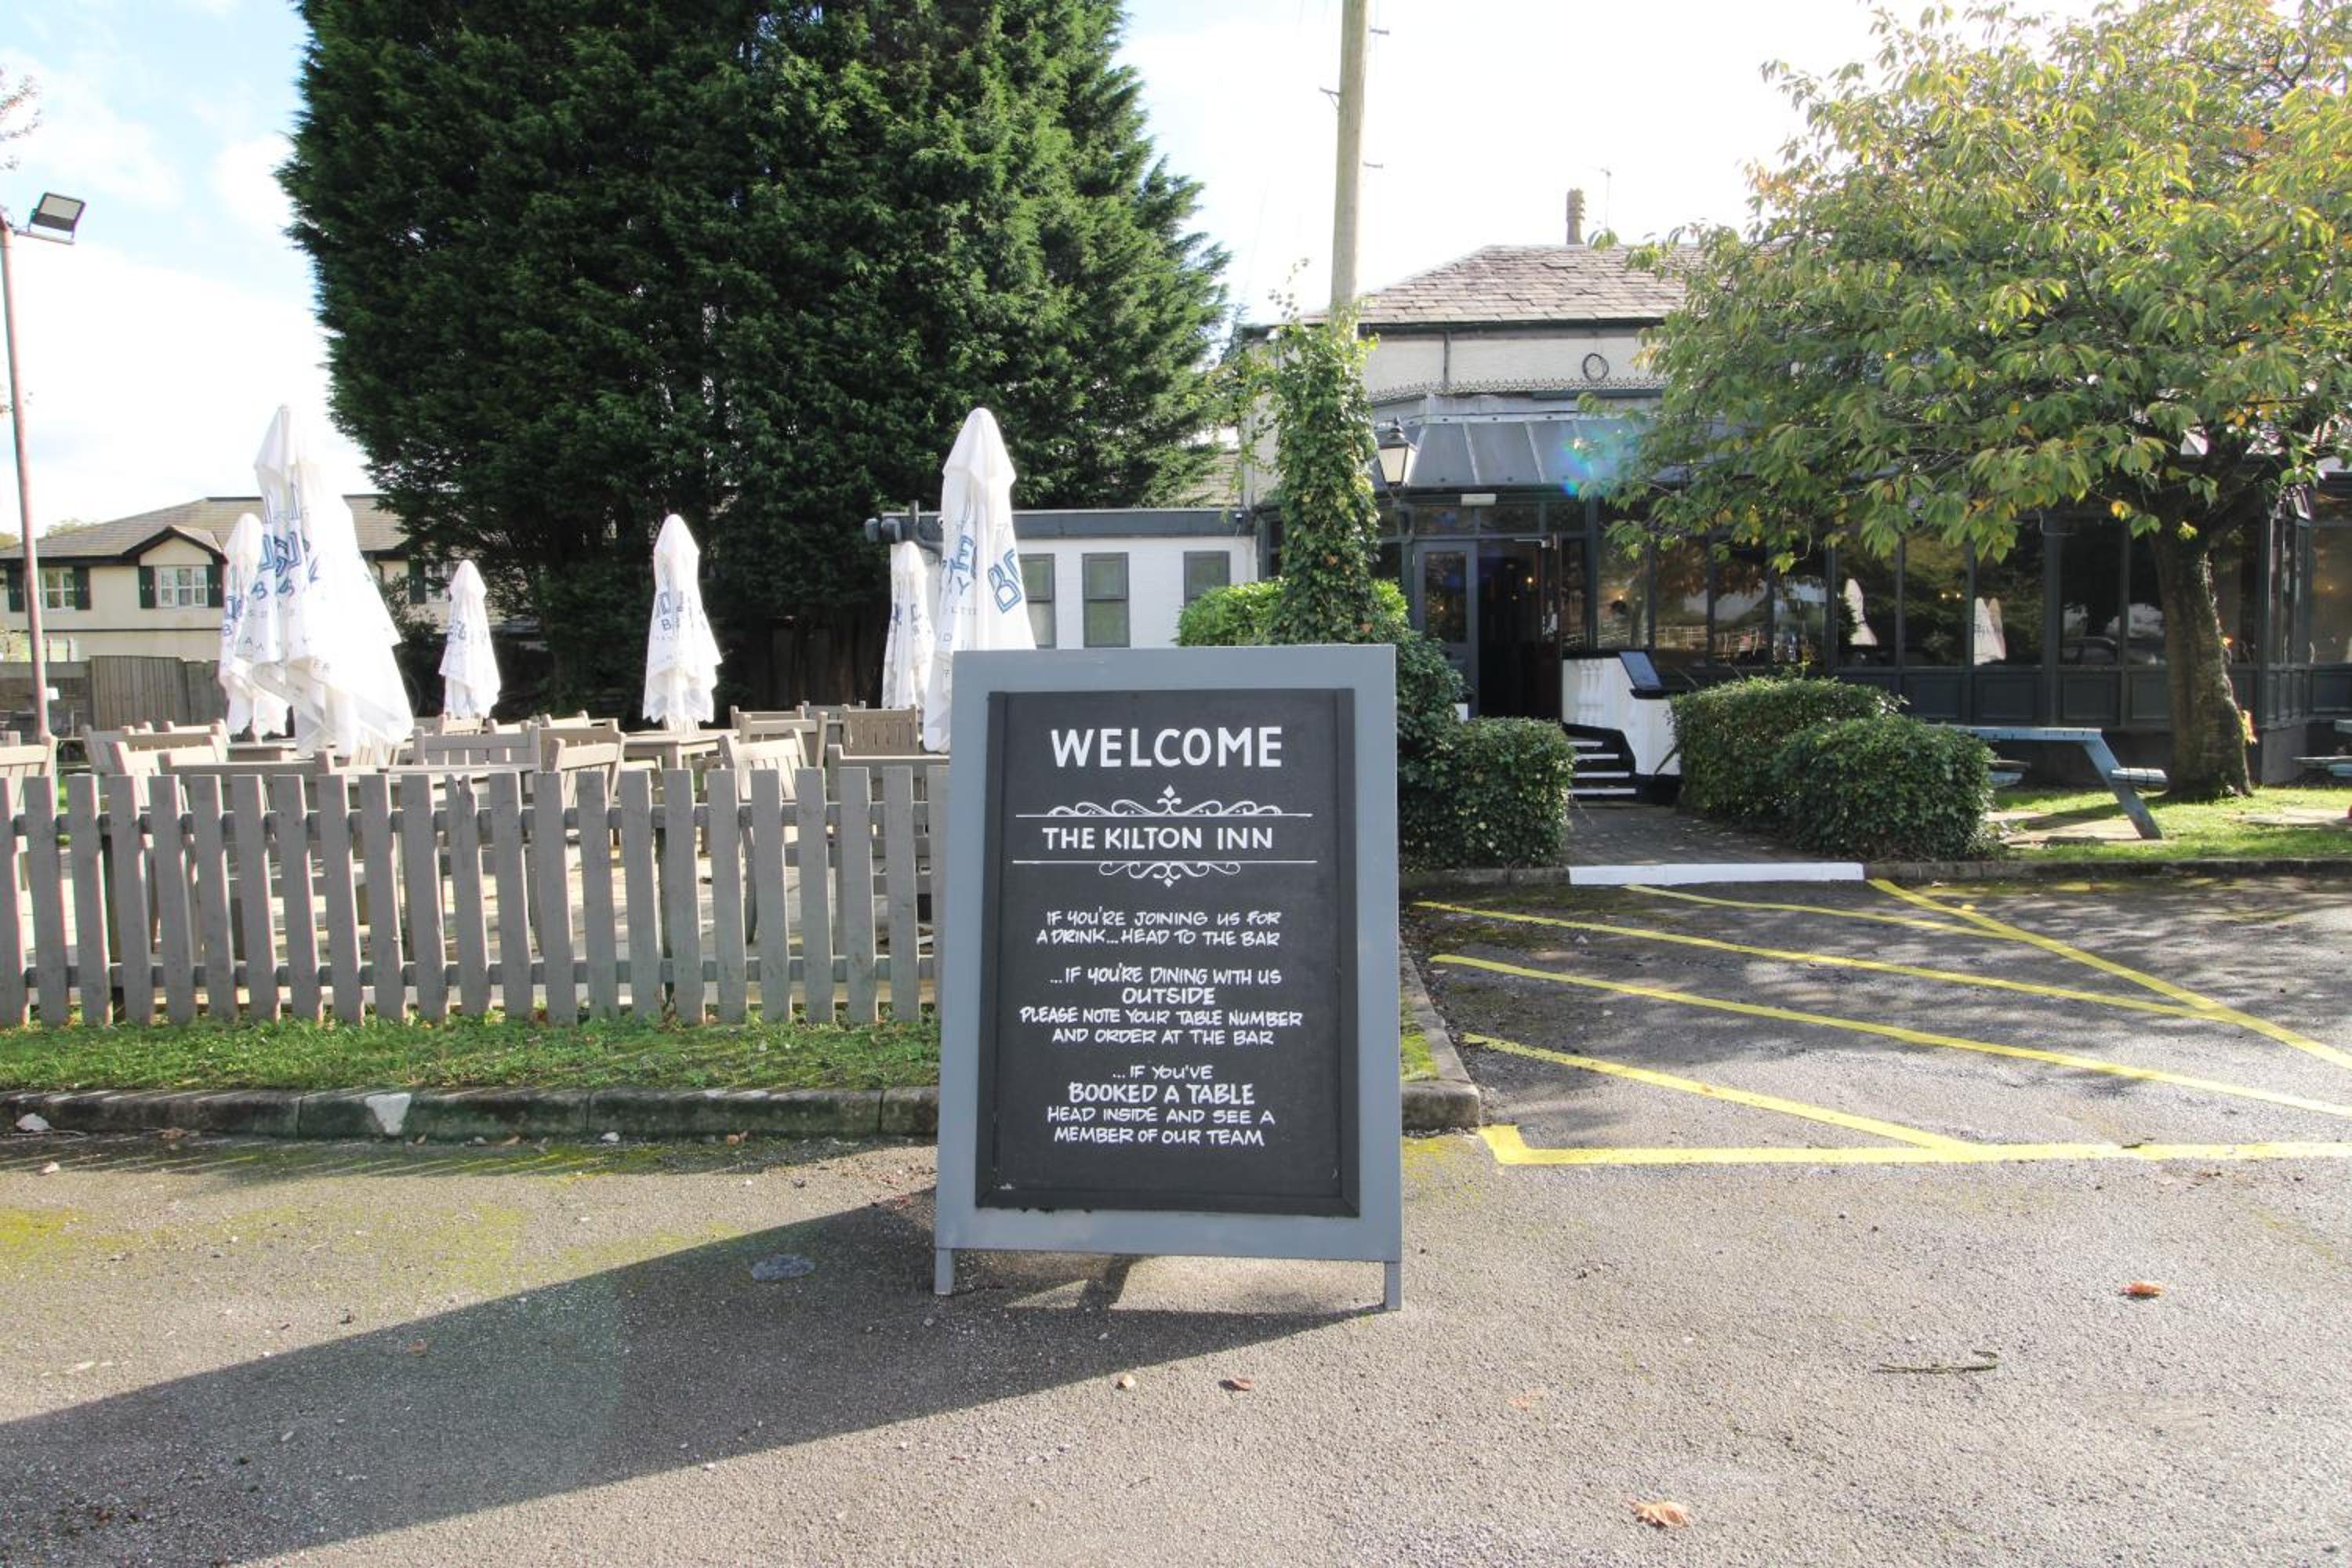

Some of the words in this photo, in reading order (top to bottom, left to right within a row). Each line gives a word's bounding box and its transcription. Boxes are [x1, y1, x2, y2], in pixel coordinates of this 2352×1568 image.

[1050, 725, 1283, 768] WELCOME
[1041, 827, 1095, 851] THE
[1104, 826, 1203, 851] KILTON
[1217, 826, 1273, 851] INN
[1047, 910, 1062, 926] IF
[1066, 906, 1126, 927] YOU'RE
[1134, 911, 1209, 927] JOINING
[1216, 912, 1241, 927] US
[1246, 909, 1283, 926] FOR
[1036, 928, 1048, 944] A
[1174, 928, 1196, 945] TO
[1201, 930, 1237, 946] THE
[1240, 931, 1281, 947] BAR
[1087, 961, 1144, 985] YOU'RE
[1149, 966, 1208, 985] DINING
[1212, 968, 1253, 985] WITH
[1257, 968, 1283, 985] US
[1121, 987, 1216, 1006] OUTSIDE
[1019, 1006, 1080, 1024] PLEASE
[1082, 1007, 1121, 1024] NOTE
[1124, 1008, 1171, 1025] YOUR
[1174, 1009, 1223, 1026] TABLE
[1228, 1009, 1304, 1028] NUMBER
[1051, 1027, 1089, 1043] AND
[1094, 1029, 1156, 1044] ORDER
[1160, 1029, 1184, 1045] AT
[1189, 1028, 1225, 1046] THE
[1232, 1029, 1274, 1046] BAR
[1151, 1064, 1214, 1080] YOU'VE
[1067, 1081, 1158, 1104] BOOKED
[1163, 1084, 1180, 1105] A
[1185, 1083, 1255, 1106] TABLE
[1047, 1105, 1096, 1123] HEAD
[1102, 1106, 1158, 1123] INSIDE
[1166, 1108, 1206, 1123] AND
[1211, 1109, 1252, 1125] SEE
[1259, 1109, 1276, 1125] A
[1054, 1127, 1134, 1144] MEMBER
[1137, 1128, 1159, 1143] OF
[1161, 1129, 1202, 1145] OUR
[1205, 1128, 1265, 1147] TEAM
